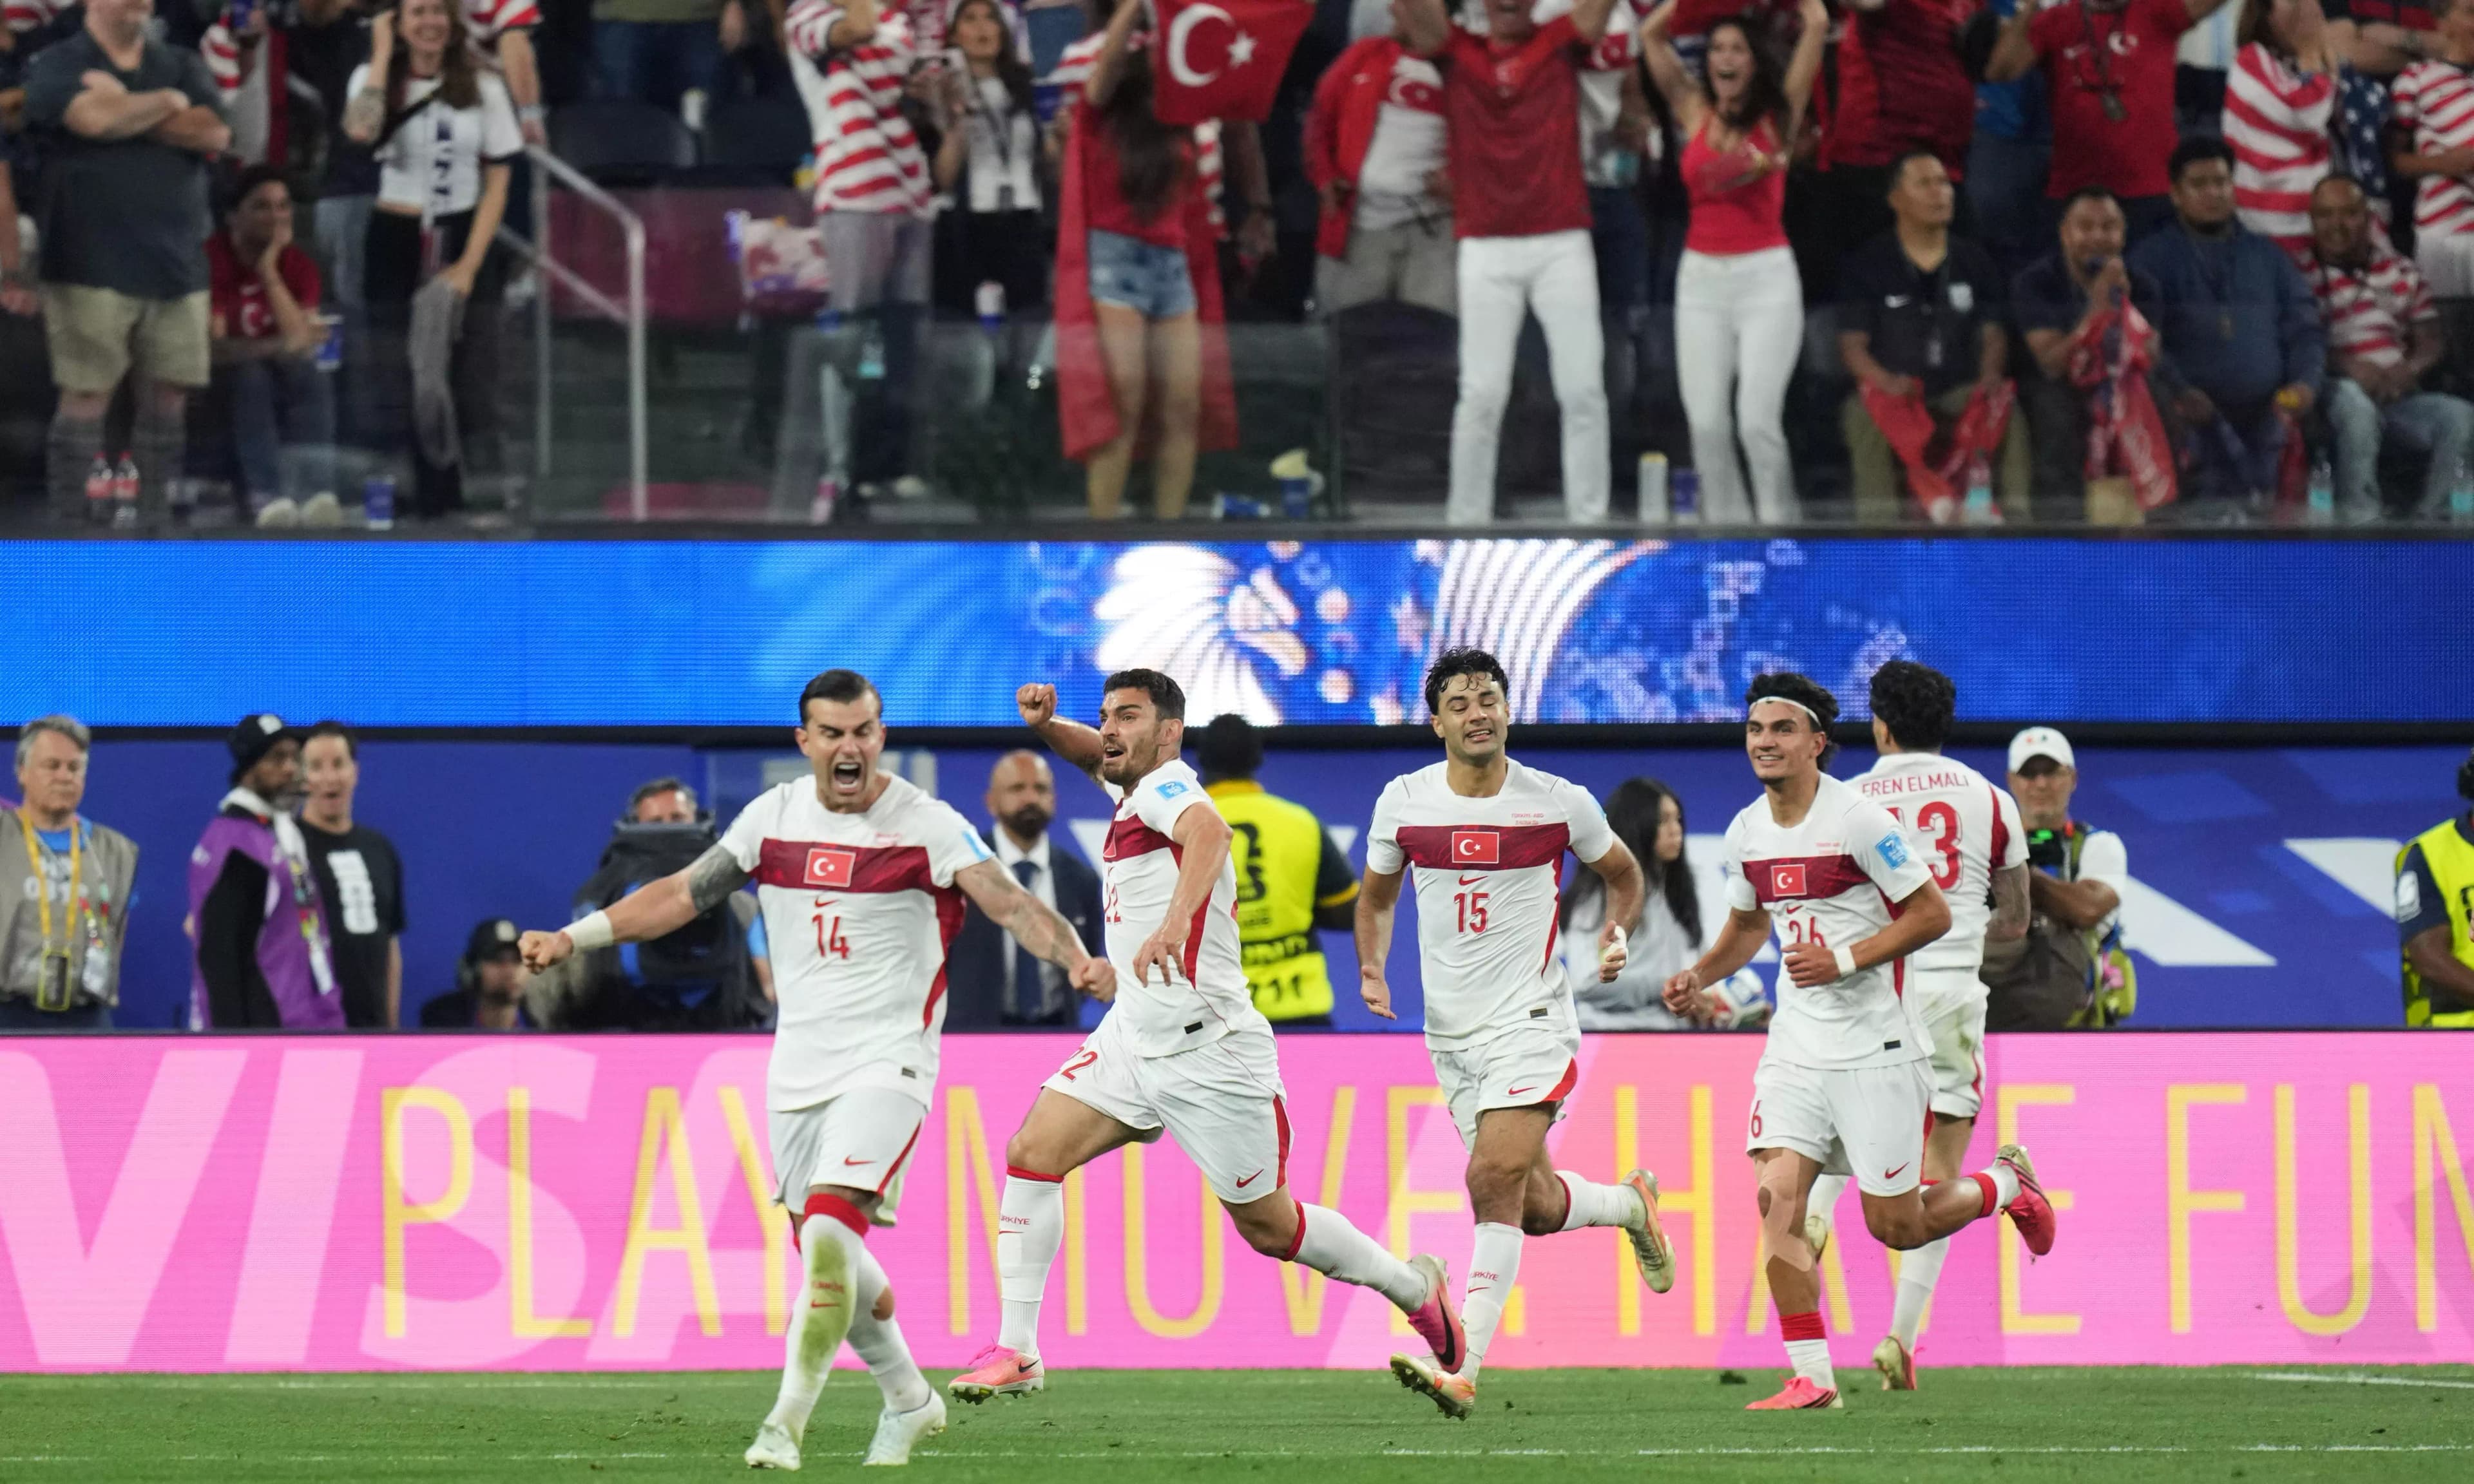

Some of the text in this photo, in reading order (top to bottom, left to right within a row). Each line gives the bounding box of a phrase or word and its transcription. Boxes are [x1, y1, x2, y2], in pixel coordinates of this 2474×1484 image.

[1862, 772, 1969, 797] EREN ELMALI
[1886, 801, 1962, 893] 3
[1454, 892, 1490, 934] 15
[812, 914, 850, 959] 14
[1061, 1045, 1098, 1081] 2
[0, 1043, 858, 1367] VISA
[1001, 1215, 1031, 1225] RKİYE
[1616, 1084, 2082, 1336] HE
